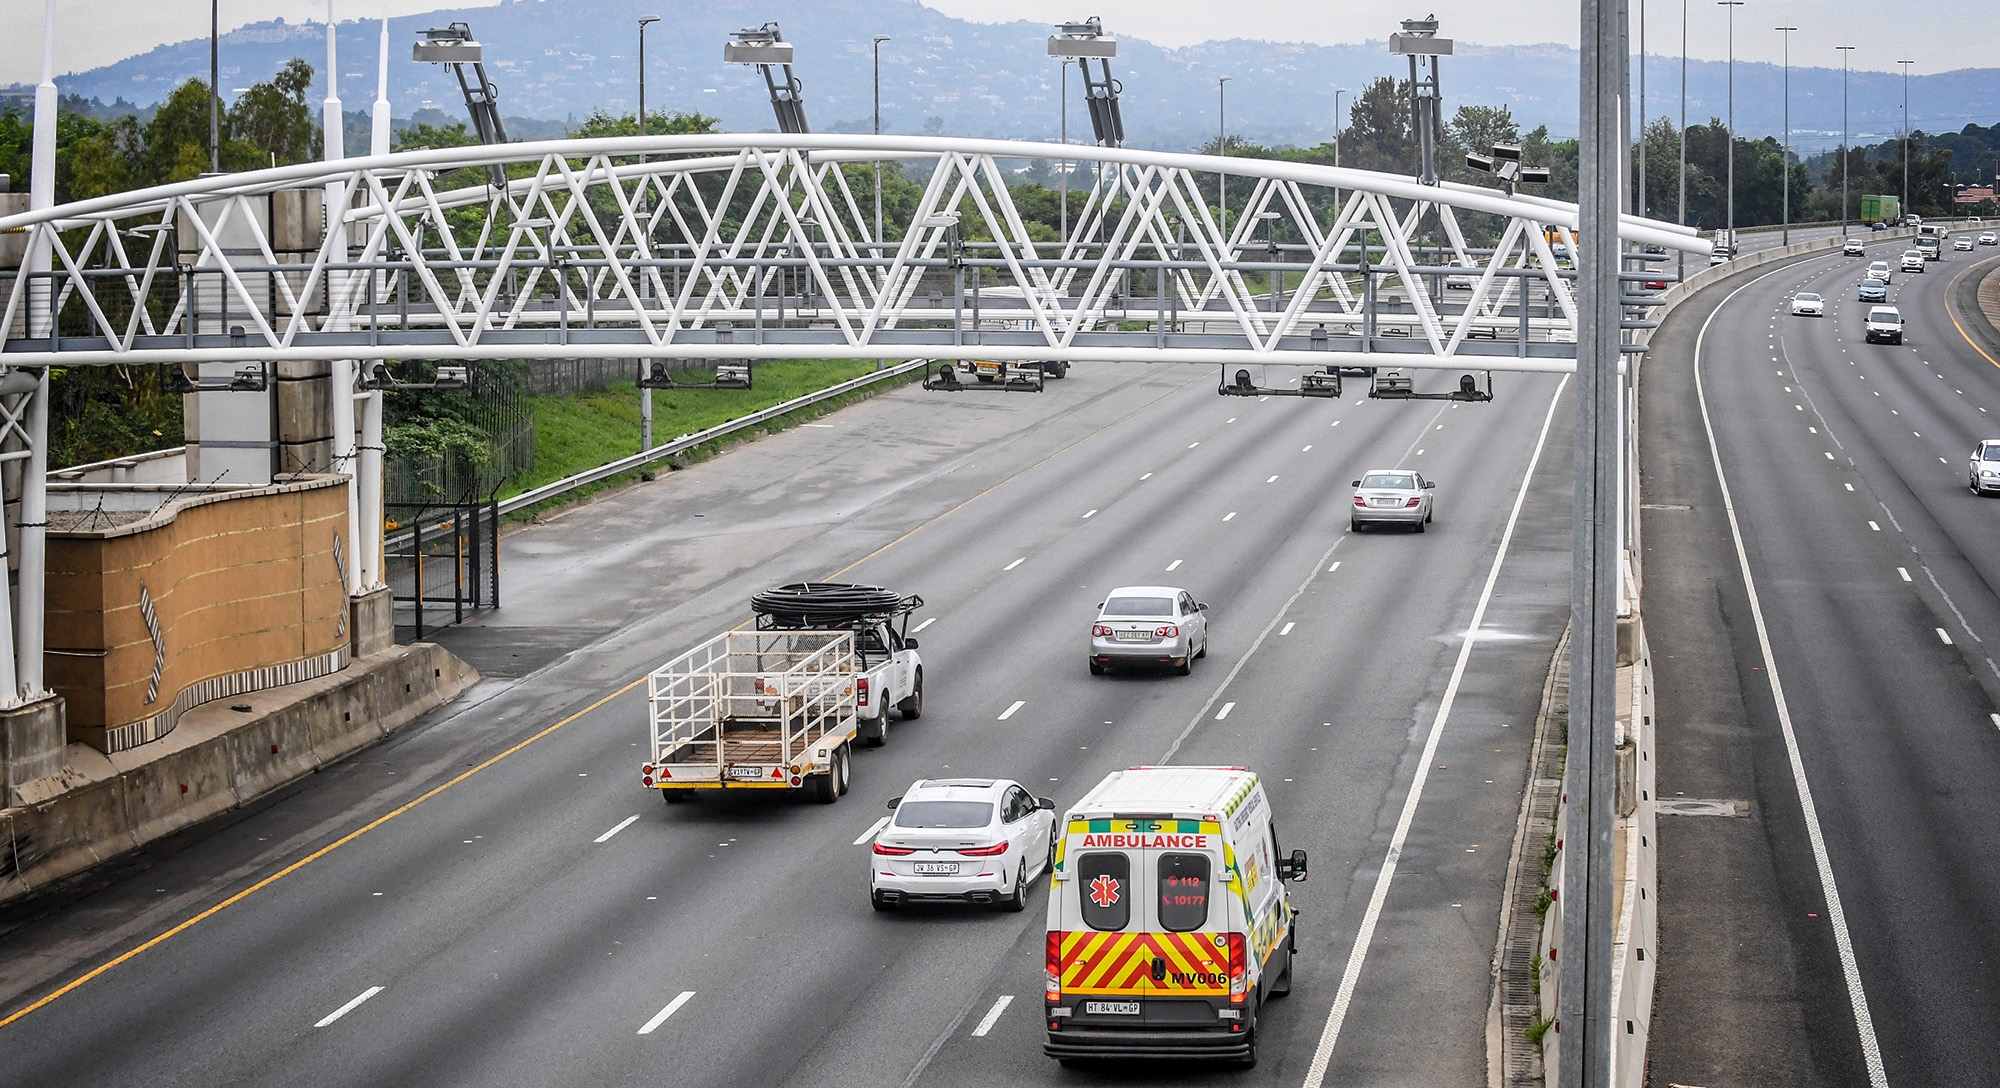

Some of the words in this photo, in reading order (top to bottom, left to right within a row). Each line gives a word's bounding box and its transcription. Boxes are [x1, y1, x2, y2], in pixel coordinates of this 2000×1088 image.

[1083, 835, 1207, 848] AMBULANCE
[1181, 877, 1200, 887] 112
[1174, 895, 1205, 905] 10177
[1172, 972, 1227, 985] MV006
[1088, 1003, 1098, 1012] HT
[1100, 1003, 1110, 1012] 84
